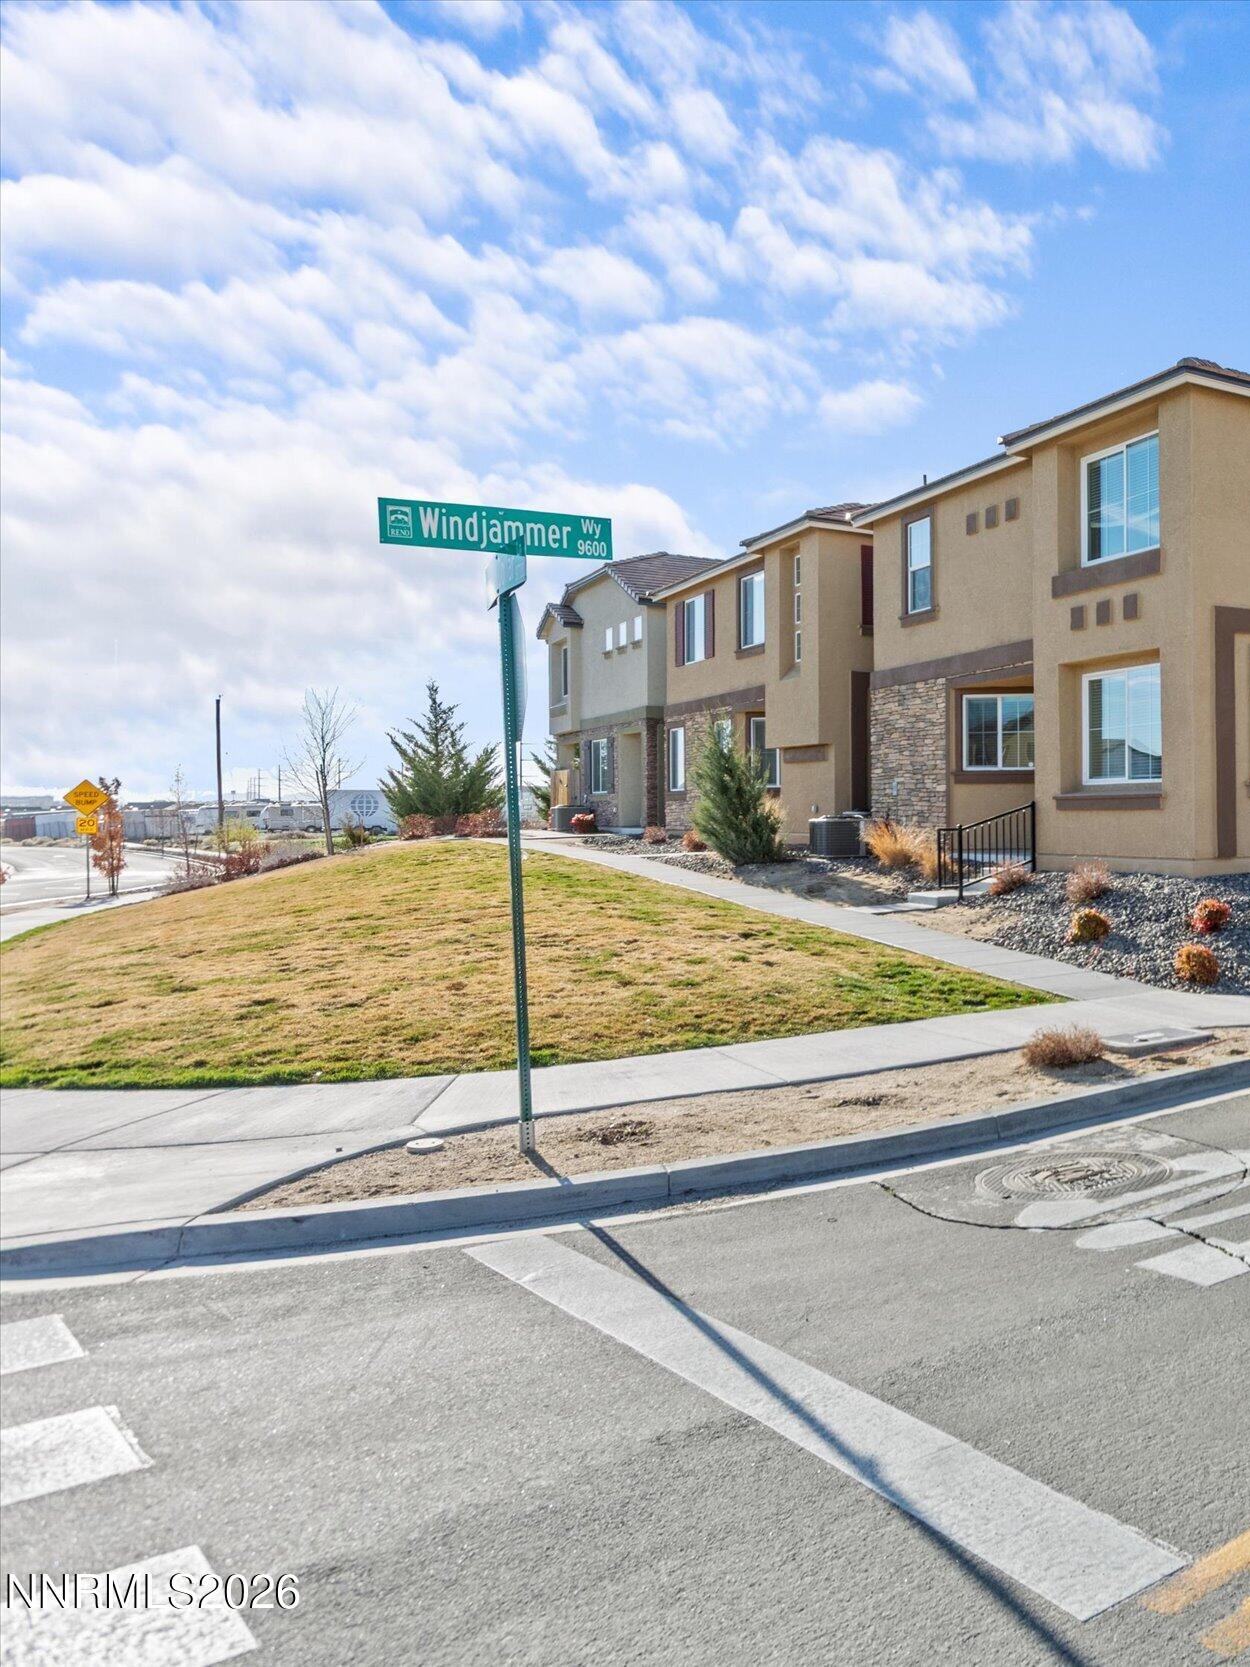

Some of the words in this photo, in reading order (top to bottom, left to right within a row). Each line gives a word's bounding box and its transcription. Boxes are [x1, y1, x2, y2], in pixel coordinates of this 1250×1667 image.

[390, 528, 410, 536] RENO
[418, 506, 572, 549] Windjammer
[580, 518, 602, 537] Wy
[576, 539, 607, 557] 9600
[79, 819, 95, 827] 20
